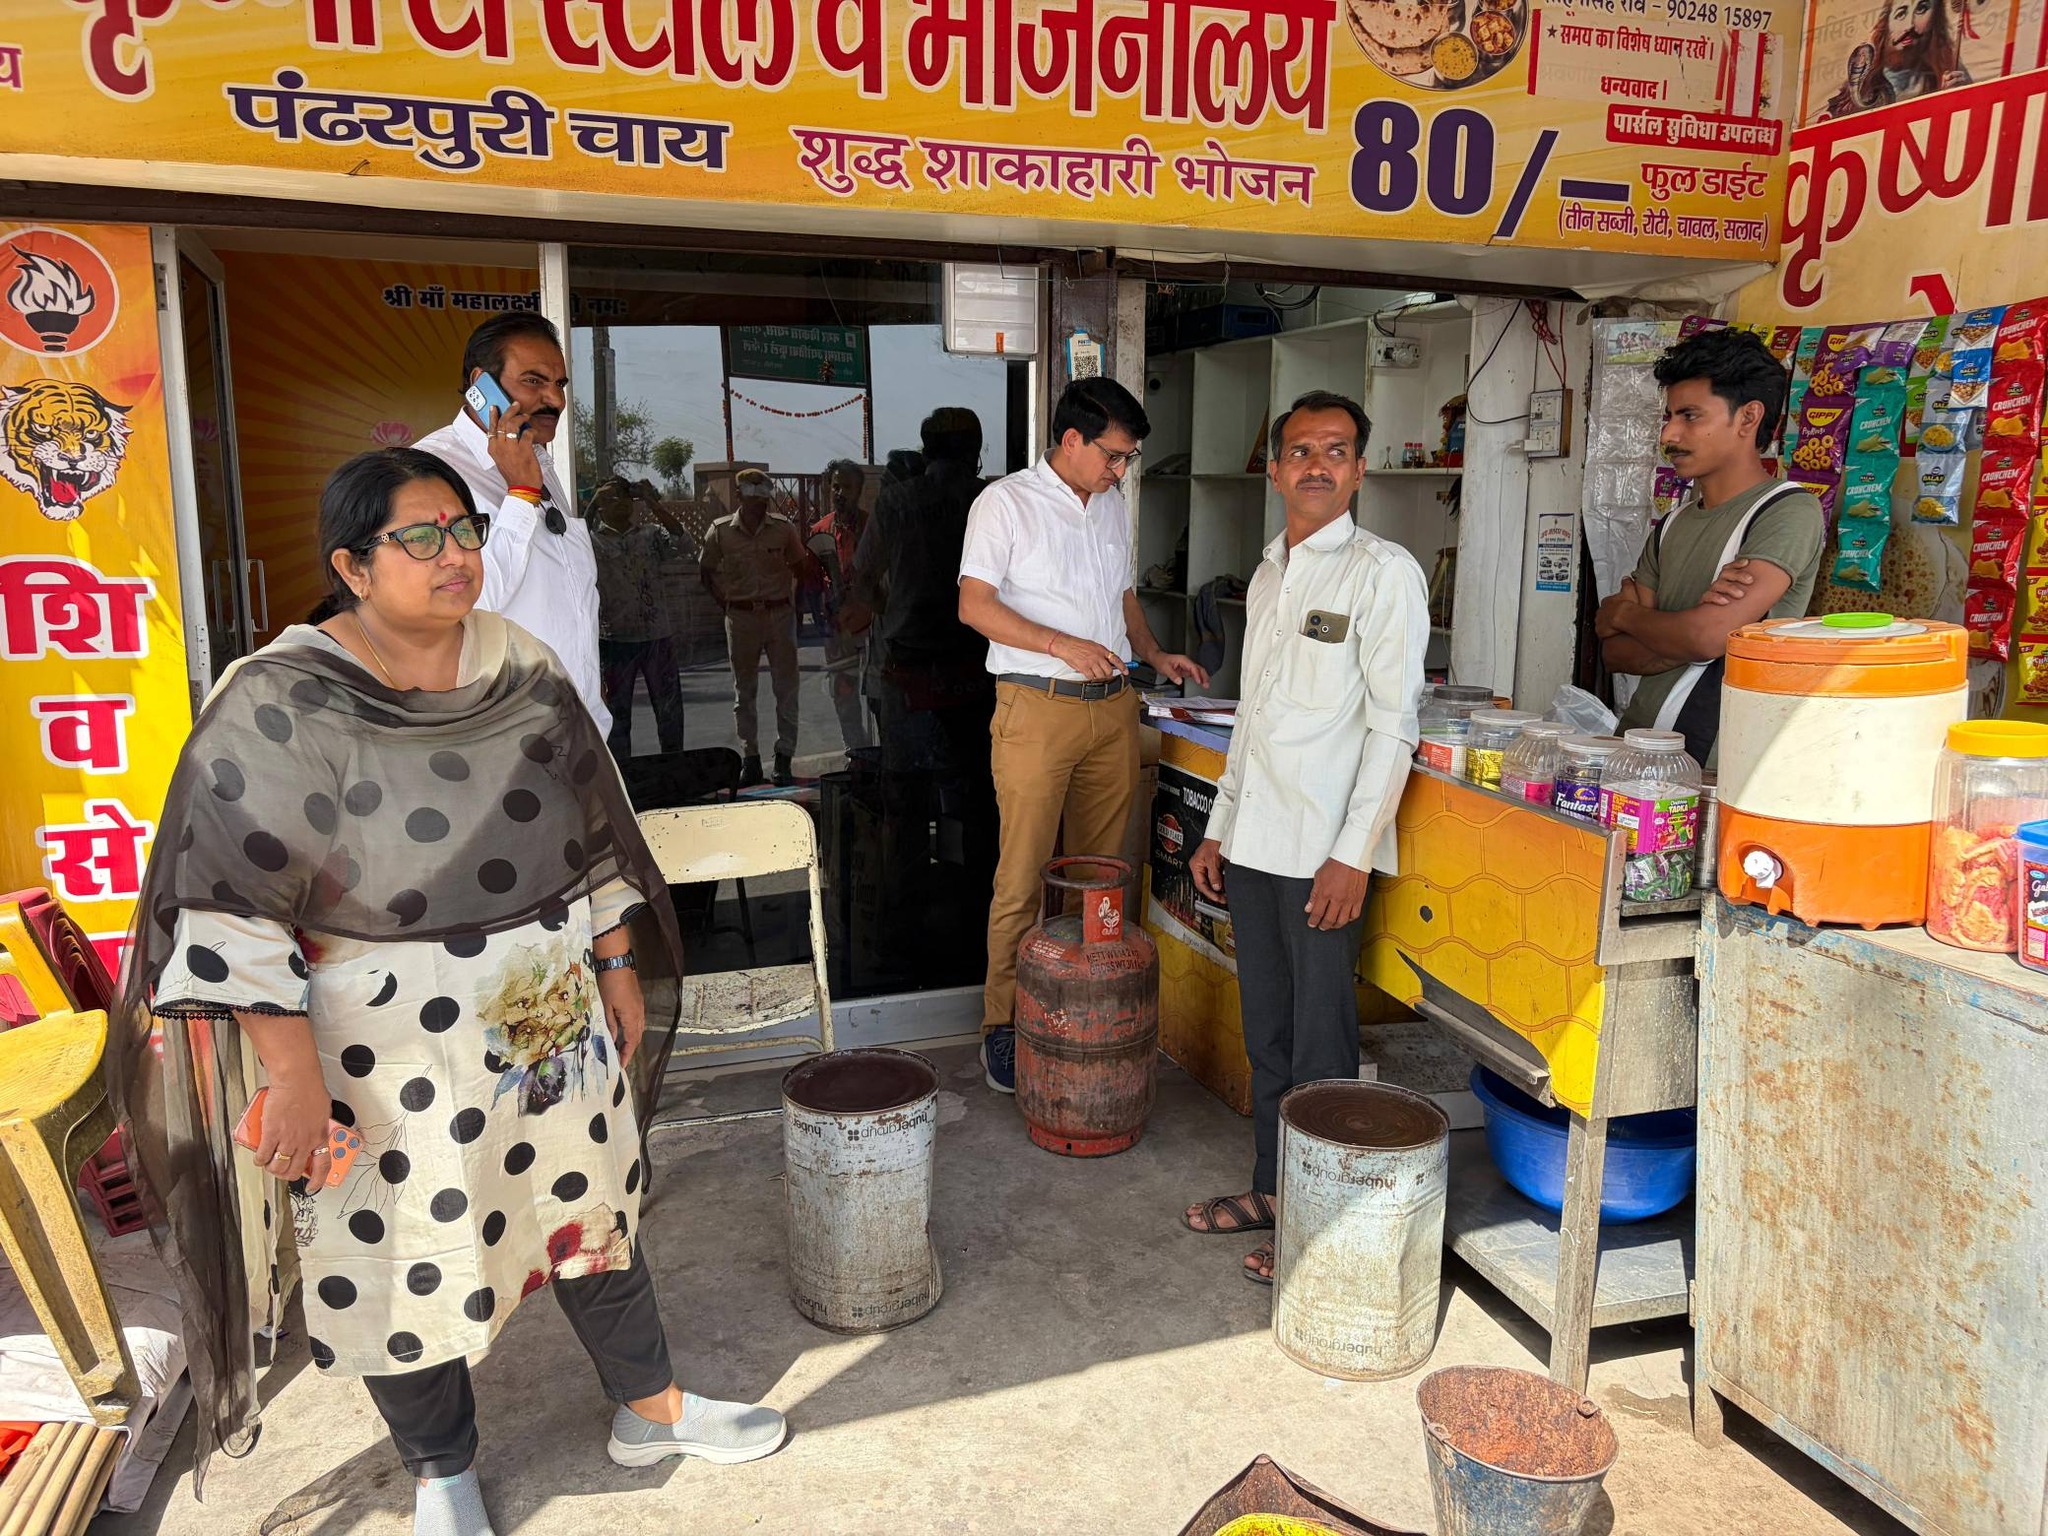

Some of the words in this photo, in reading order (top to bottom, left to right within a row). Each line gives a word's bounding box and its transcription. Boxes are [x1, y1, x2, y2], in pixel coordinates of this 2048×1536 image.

[1666, 3, 1718, 24] 90248
[1724, 6, 1773, 30] 15897
[1561, 24, 1594, 47] समय
[1596, 28, 1615, 49] का
[1616, 26, 1652, 53] विशेष
[1654, 35, 1683, 57] ध्यान
[1600, 76, 1659, 100] धन्यवाद
[227, 70, 555, 169] पंढरपुरी
[568, 111, 730, 169] चाय
[1613, 109, 1664, 136] पार्सल
[1666, 114, 1717, 144] सुविधा
[1720, 121, 1777, 146] उपलब्ध
[795, 129, 910, 193] शुद्ध
[920, 137, 1163, 199] शाकाहारी
[1177, 140, 1316, 204] भोजन
[1641, 162, 1700, 200] फुल
[1702, 161, 1768, 201] डाईट
[1559, 200, 1595, 238] (तीन
[1642, 208, 1673, 240] रोटी,
[1676, 216, 1720, 243] चावल,
[1724, 212, 1770, 250] सलाद)
[384, 285, 413, 308] श्री
[1808, 410, 1838, 420] GIPPI
[1182, 786, 1208, 814] TOBACCO
[1155, 850, 1184, 871] SMART
[861, 1112, 929, 1139] hubergroup
[1311, 1165, 1396, 1191] hubergroup
